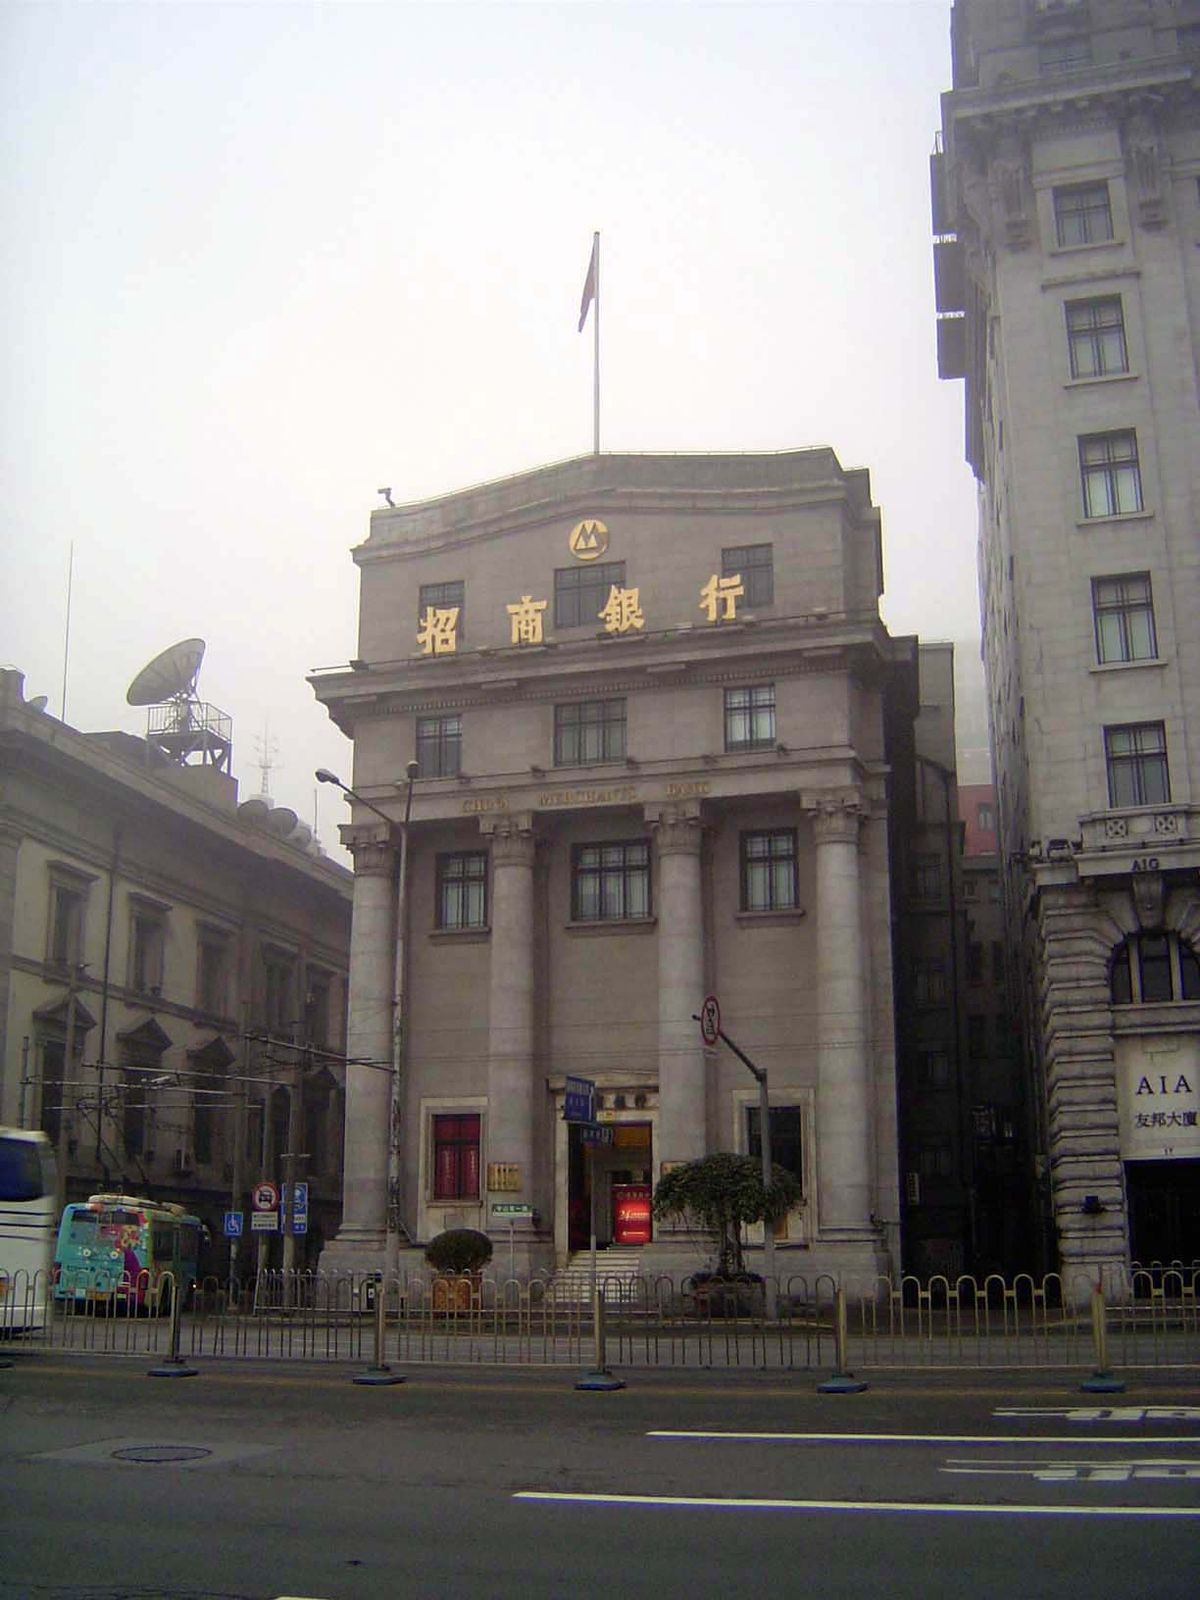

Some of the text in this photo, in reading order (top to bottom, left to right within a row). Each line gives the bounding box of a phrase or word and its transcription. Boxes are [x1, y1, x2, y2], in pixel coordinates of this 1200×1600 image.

[416, 574, 745, 655] 招商銀行
[1131, 858, 1160, 871] AIG
[1136, 1074, 1193, 1096] AIA
